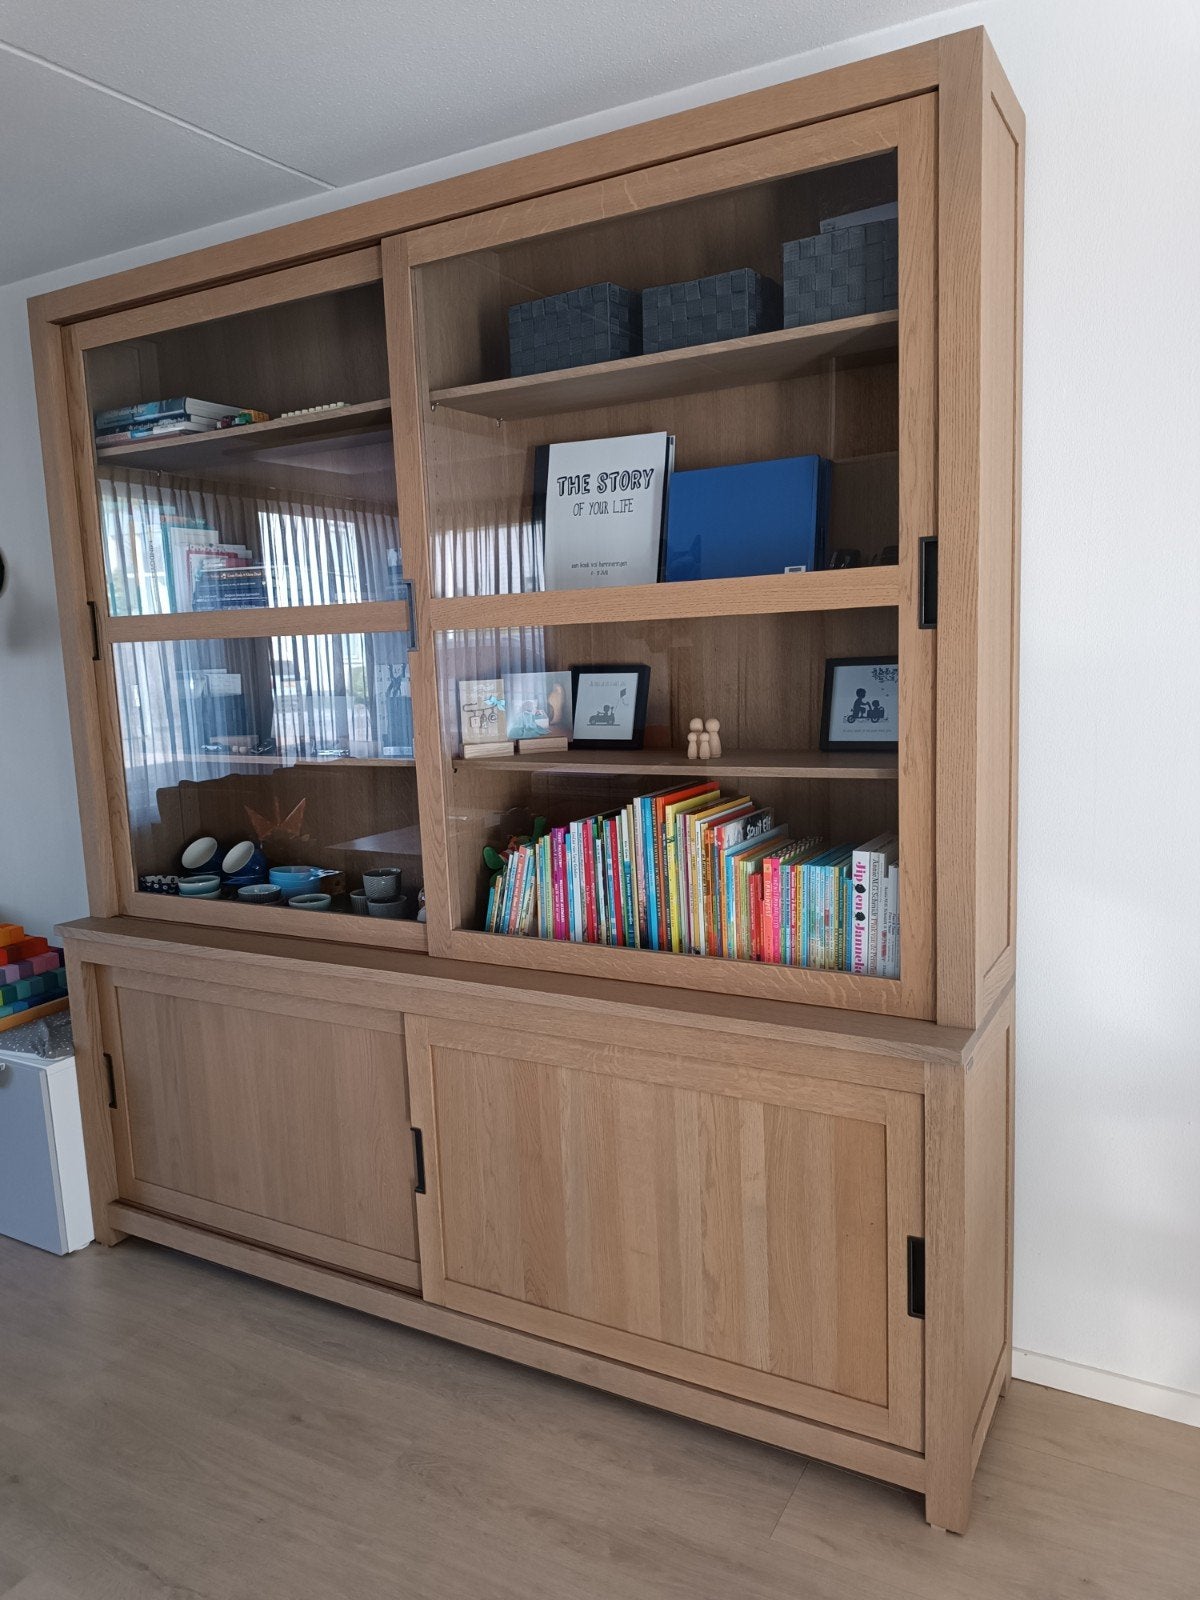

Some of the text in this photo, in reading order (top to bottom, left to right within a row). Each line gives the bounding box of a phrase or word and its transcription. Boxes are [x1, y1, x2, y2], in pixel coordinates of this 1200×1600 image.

[557, 468, 655, 496] THE STORY
[572, 498, 634, 517] OF YOUR LIFE
[854, 861, 867, 882] Jip
[856, 894, 865, 910] en
